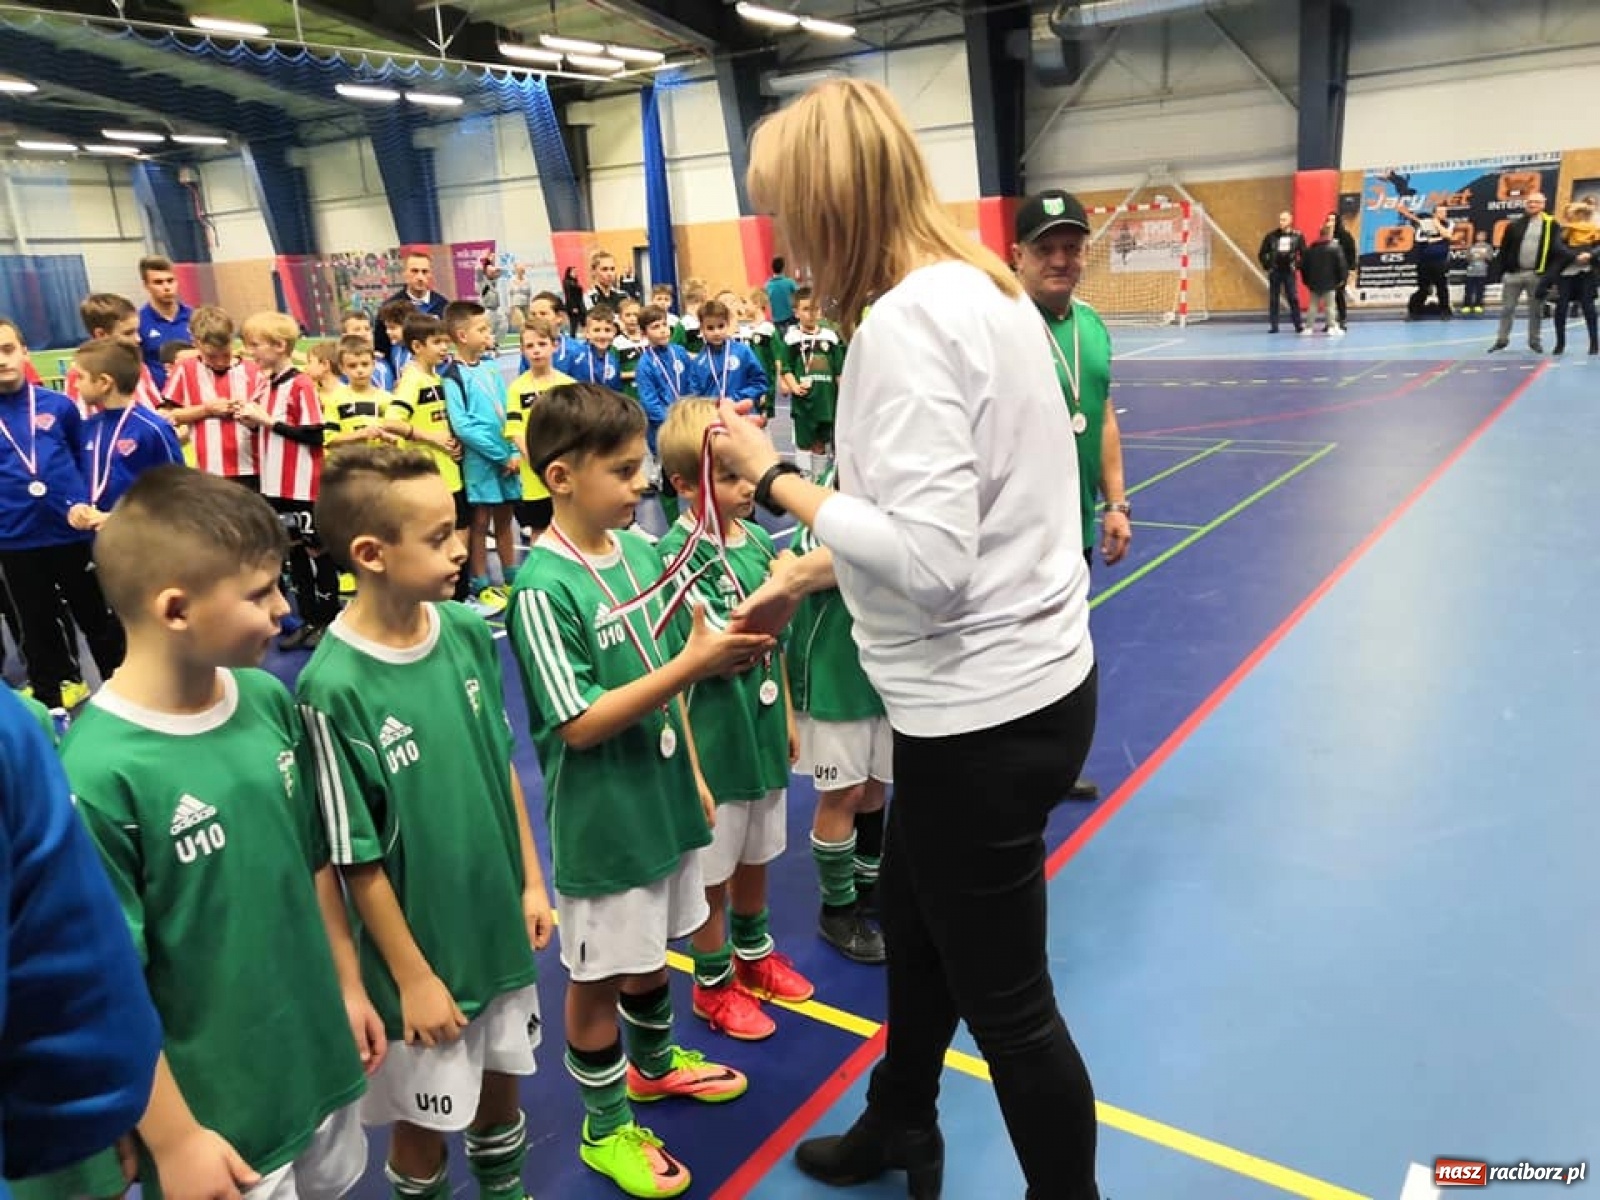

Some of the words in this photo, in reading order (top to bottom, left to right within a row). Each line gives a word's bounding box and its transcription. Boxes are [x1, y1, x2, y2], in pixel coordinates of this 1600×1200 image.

[597, 623, 626, 650] U10
[386, 740, 419, 774] U10
[814, 764, 838, 780] U10
[175, 823, 226, 863] U10
[415, 1093, 453, 1115] U10
